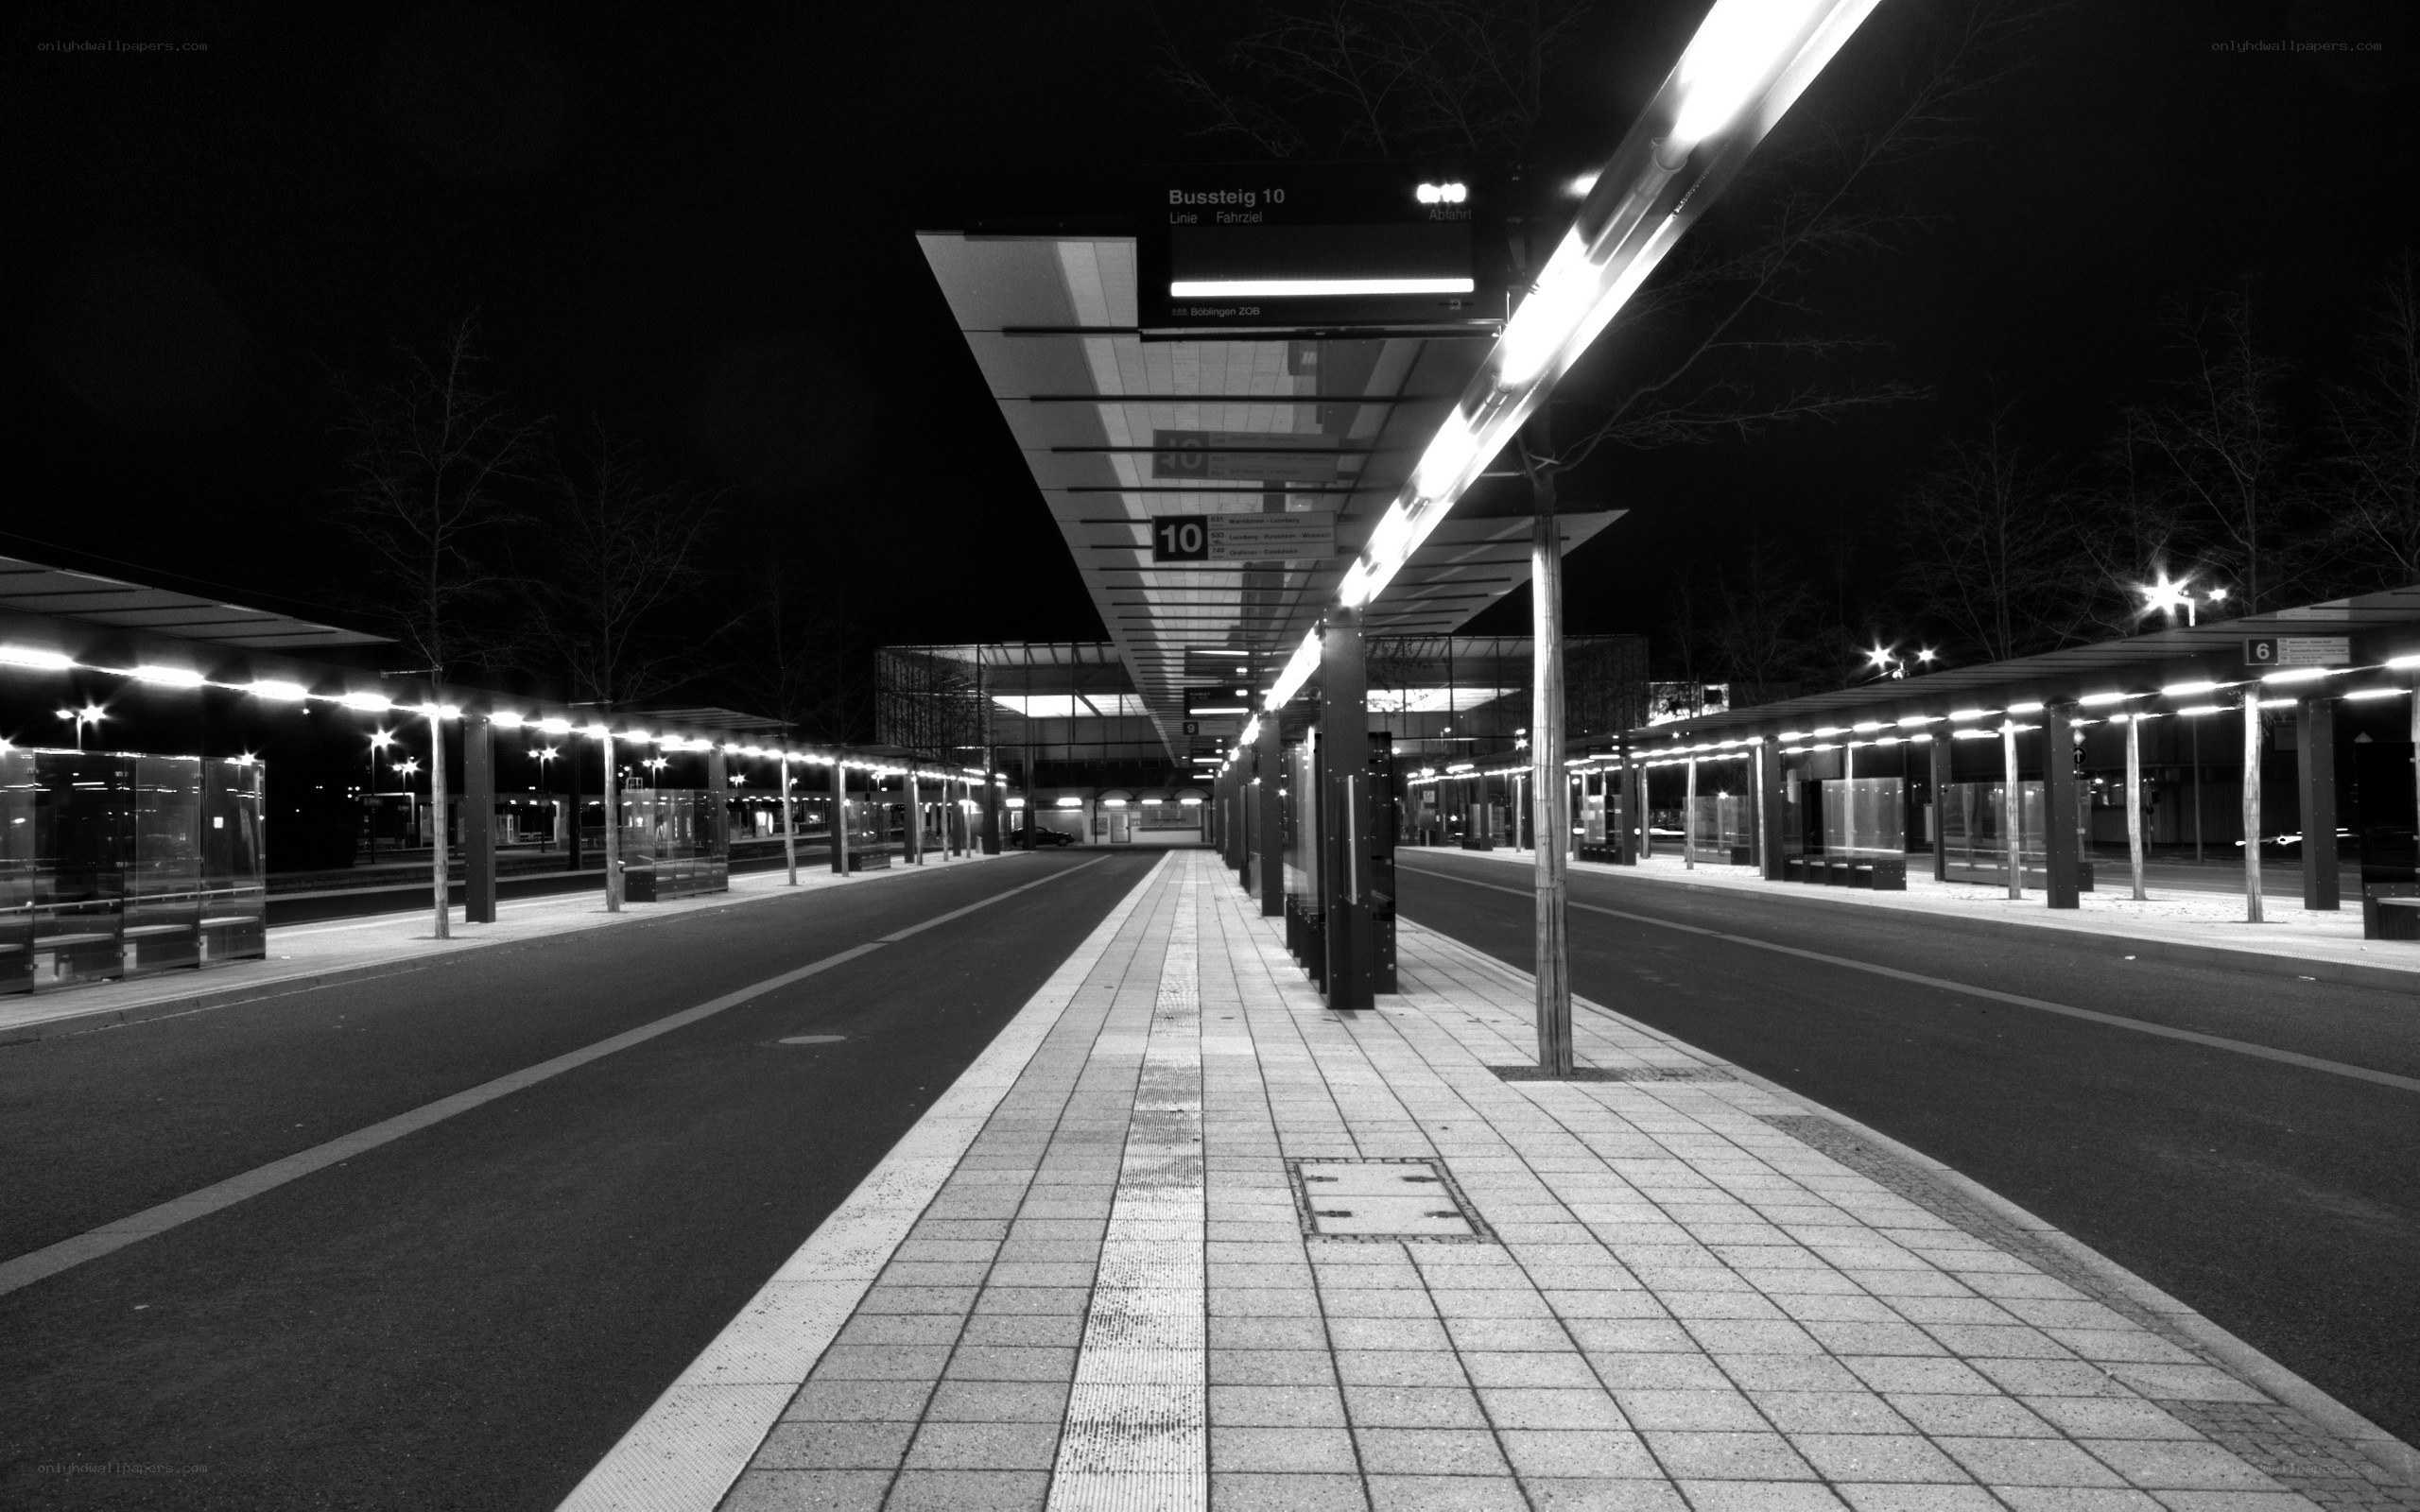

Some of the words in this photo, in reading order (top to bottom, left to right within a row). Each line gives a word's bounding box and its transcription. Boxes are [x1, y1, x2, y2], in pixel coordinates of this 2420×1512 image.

[1168, 189, 1256, 207] Bussteig
[1262, 188, 1286, 204] 10
[1169, 212, 1198, 224] Linie
[1216, 211, 1263, 223] Fahrziel
[1428, 208, 1473, 220] Abfahrt
[1190, 307, 1236, 318] Böblingen
[1238, 306, 1260, 316] ZOB
[1160, 524, 1202, 553] 10
[2256, 643, 2271, 660] 6
[1186, 723, 1196, 733] 9
